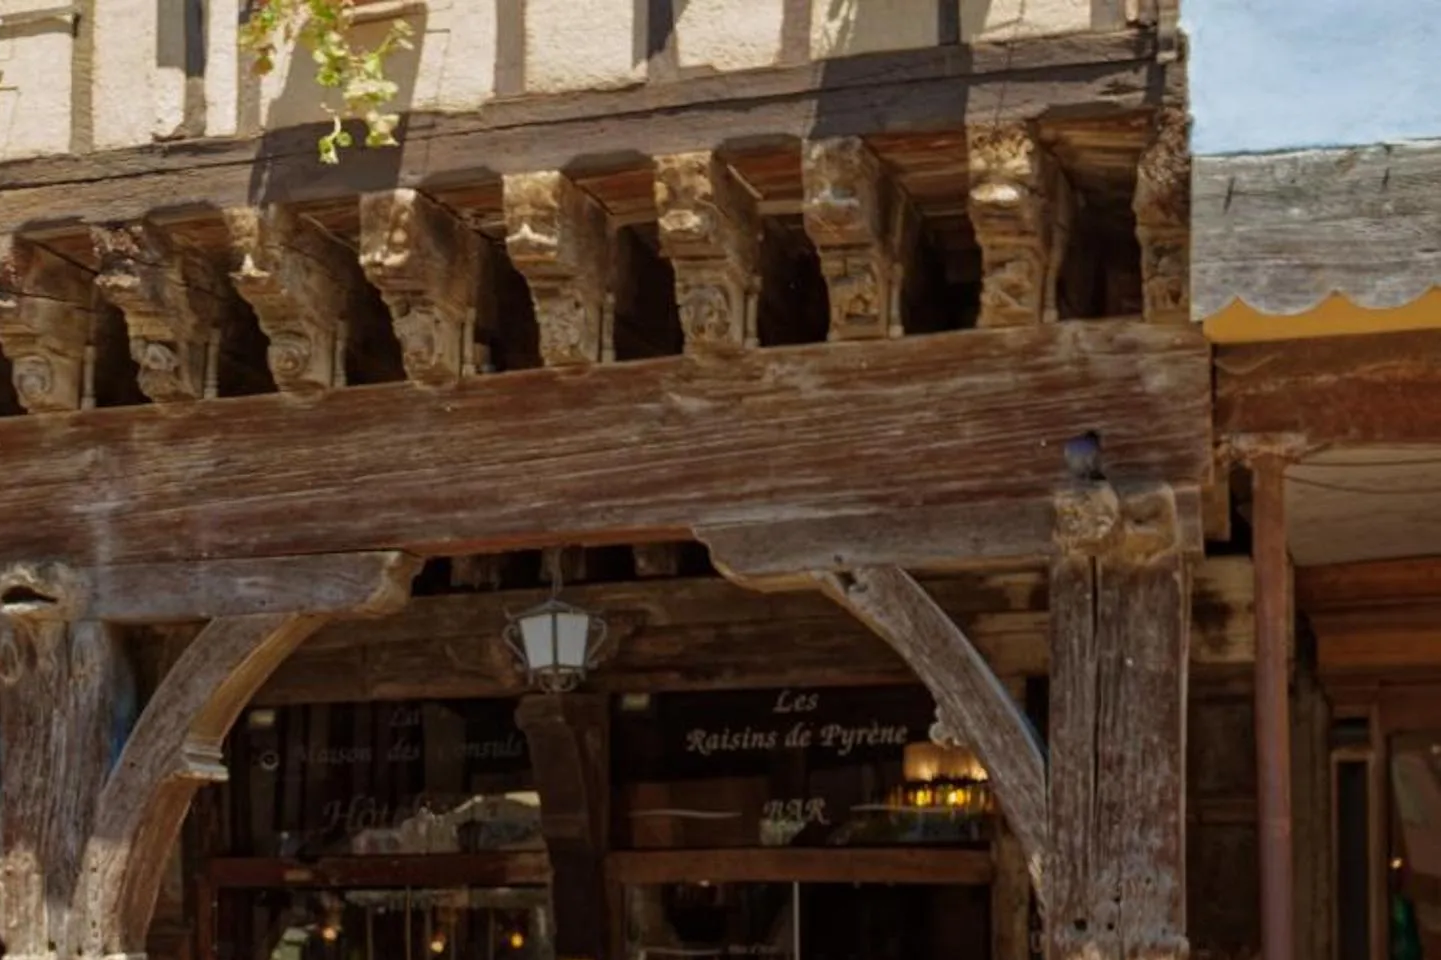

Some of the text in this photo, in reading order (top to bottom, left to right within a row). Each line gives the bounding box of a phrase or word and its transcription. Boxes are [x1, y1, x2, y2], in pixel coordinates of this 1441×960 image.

[771, 689, 820, 714] Les
[437, 731, 524, 760] onsuls
[685, 717, 909, 757] Raisins de Pyrène
[762, 797, 832, 826] BAR
